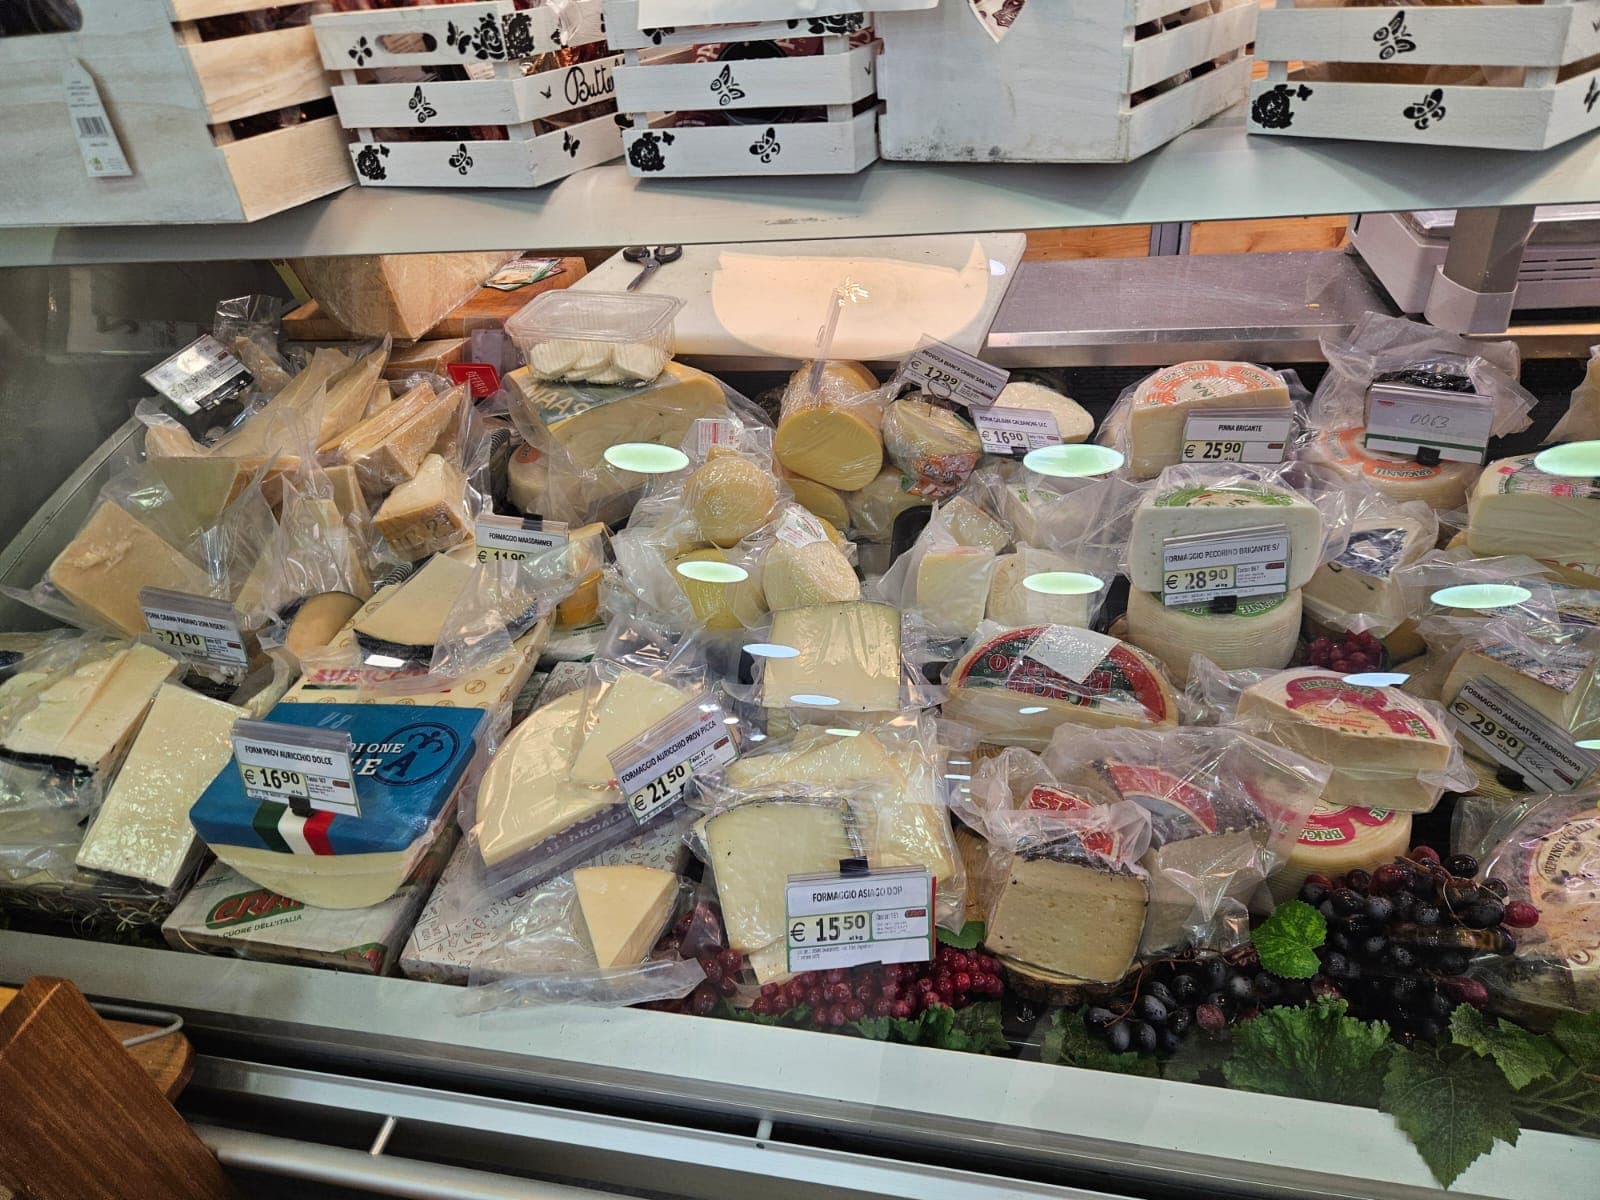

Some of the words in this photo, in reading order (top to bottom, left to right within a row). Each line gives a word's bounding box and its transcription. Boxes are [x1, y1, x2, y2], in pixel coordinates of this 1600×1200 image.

[981, 430, 992, 442] €
[1235, 424, 1263, 432] BRIGANTE
[1184, 444, 1196, 458] €
[488, 532, 518, 542] FORMAGGIO
[1205, 548, 1237, 559] PECORINO
[1239, 545, 1272, 555] BRIGANTE
[1165, 574, 1179, 590] €
[1455, 702, 1469, 716] €
[1464, 685, 1503, 715] FORMAGGIO
[1502, 713, 1542, 745] AMALATTEA
[1541, 740, 1581, 772] FIORDICAPA
[263, 746, 279, 757] PROV
[279, 750, 312, 763] AURICCHIO
[312, 755, 333, 766] DOLCE
[621, 757, 657, 784] FORMAGGIO
[656, 739, 686, 762] AURICCHIO
[686, 730, 701, 744] PROV
[700, 720, 717, 736] PICCA
[244, 769, 257, 785] €
[634, 794, 648, 811] €
[812, 890, 858, 903] FORMAGGIO
[857, 888, 887, 899] ASIAGO
[253, 914, 303, 932] DELL'ITALIA
[790, 922, 806, 943] €
